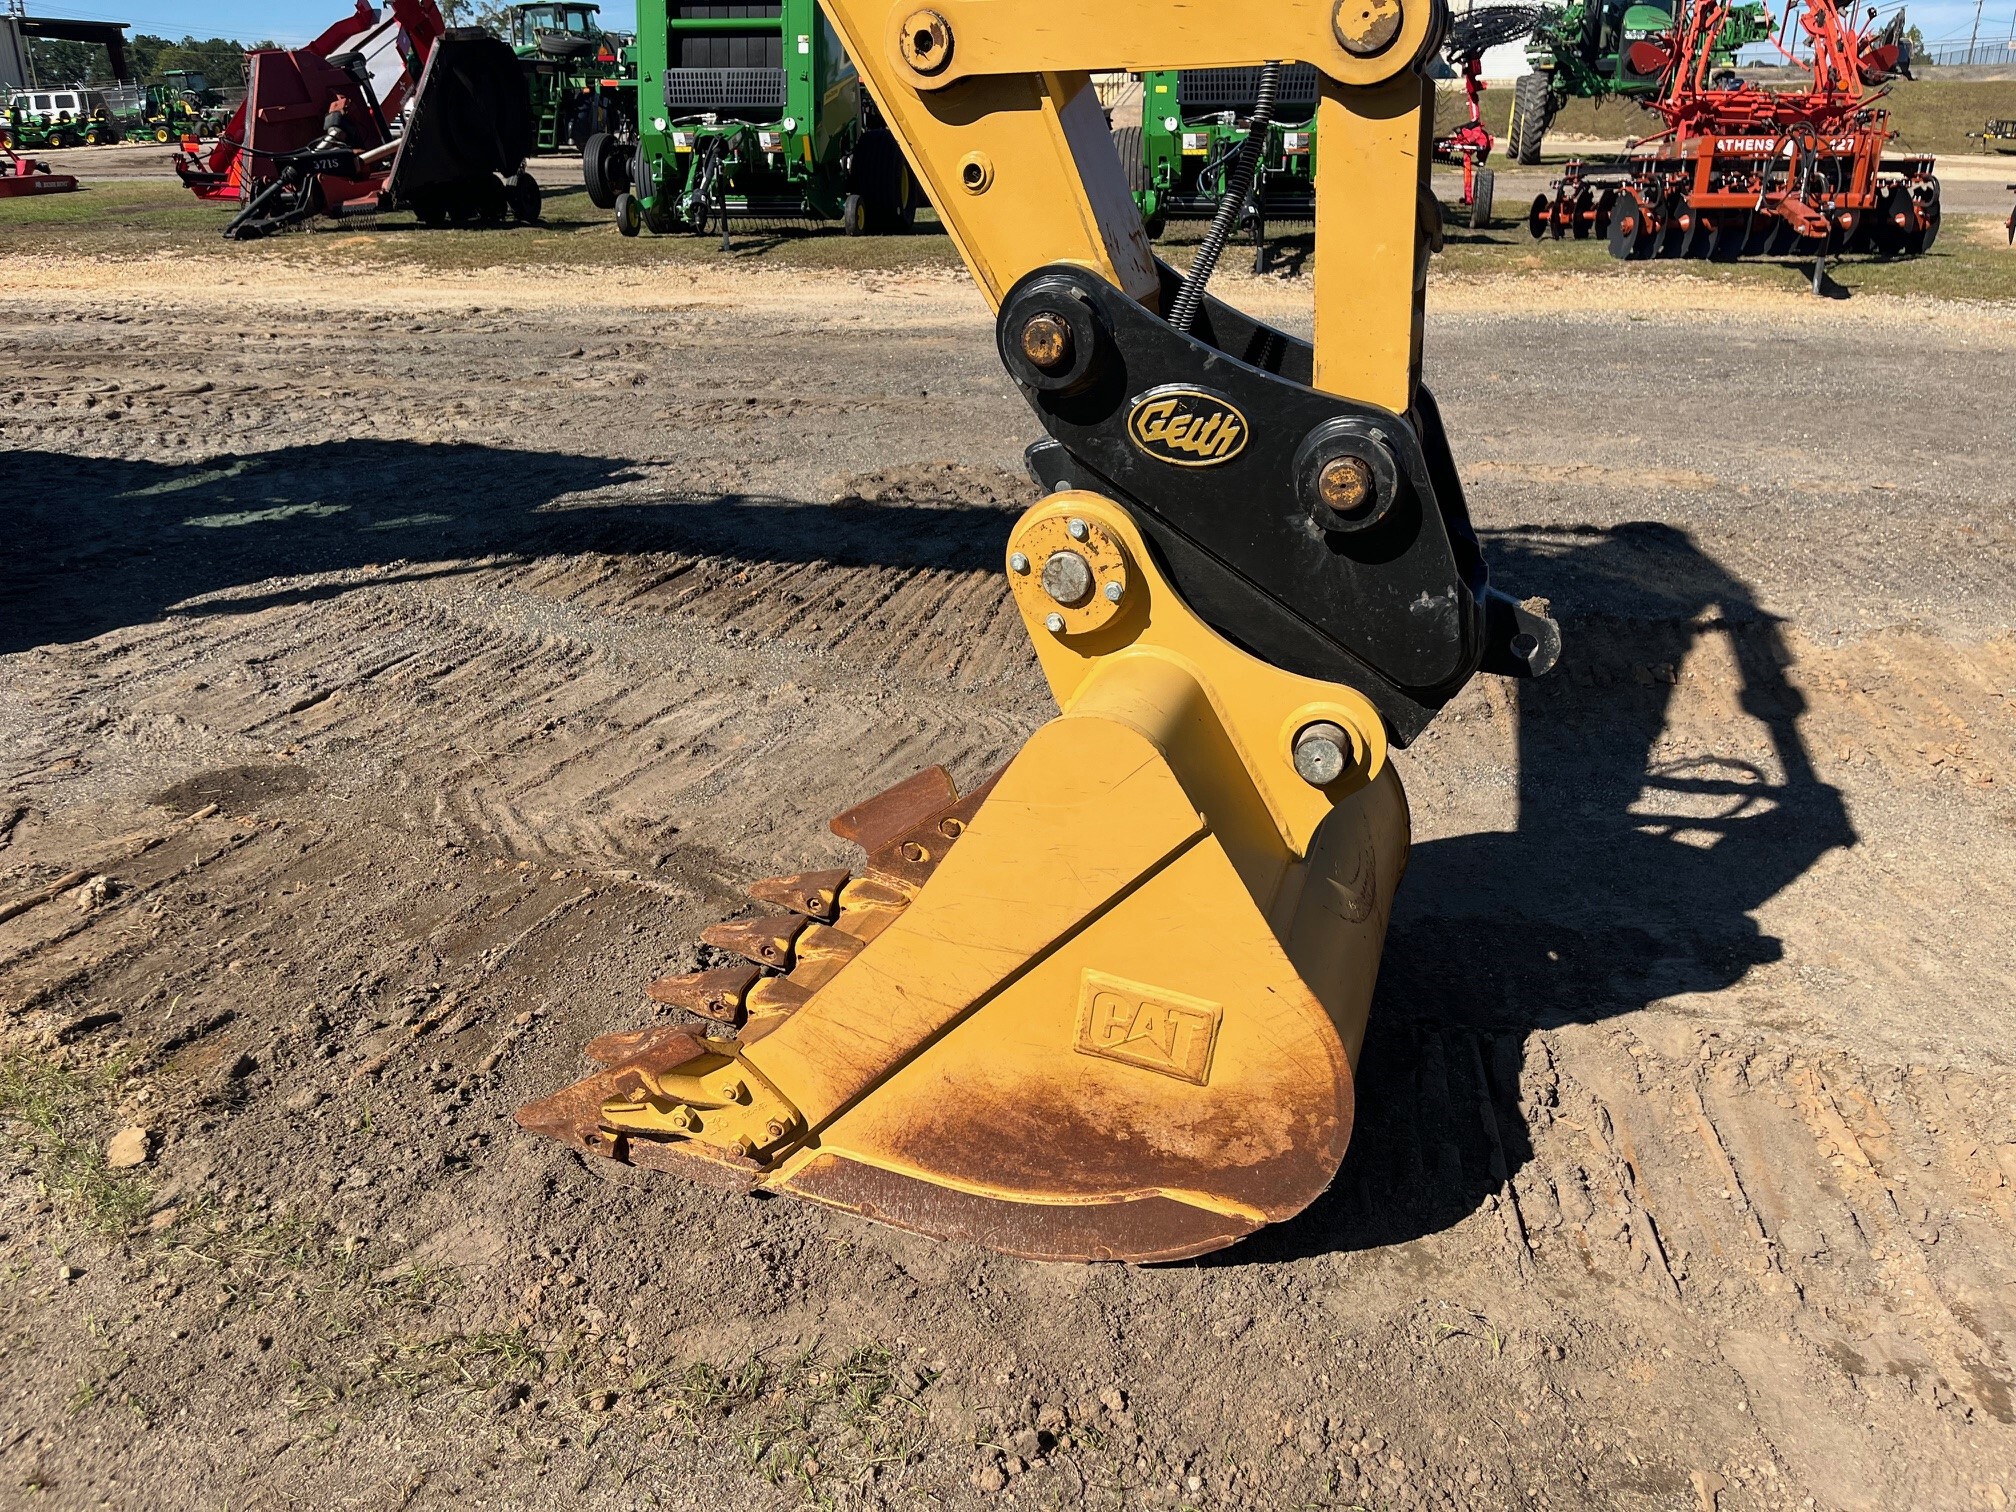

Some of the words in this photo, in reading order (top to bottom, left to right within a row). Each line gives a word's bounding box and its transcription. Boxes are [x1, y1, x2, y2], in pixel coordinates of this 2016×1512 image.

[1717, 138, 1775, 152] ATHENS
[1829, 138, 1855, 151] 127
[1137, 398, 1241, 457] Geith
[1089, 991, 1204, 1072] CAT
